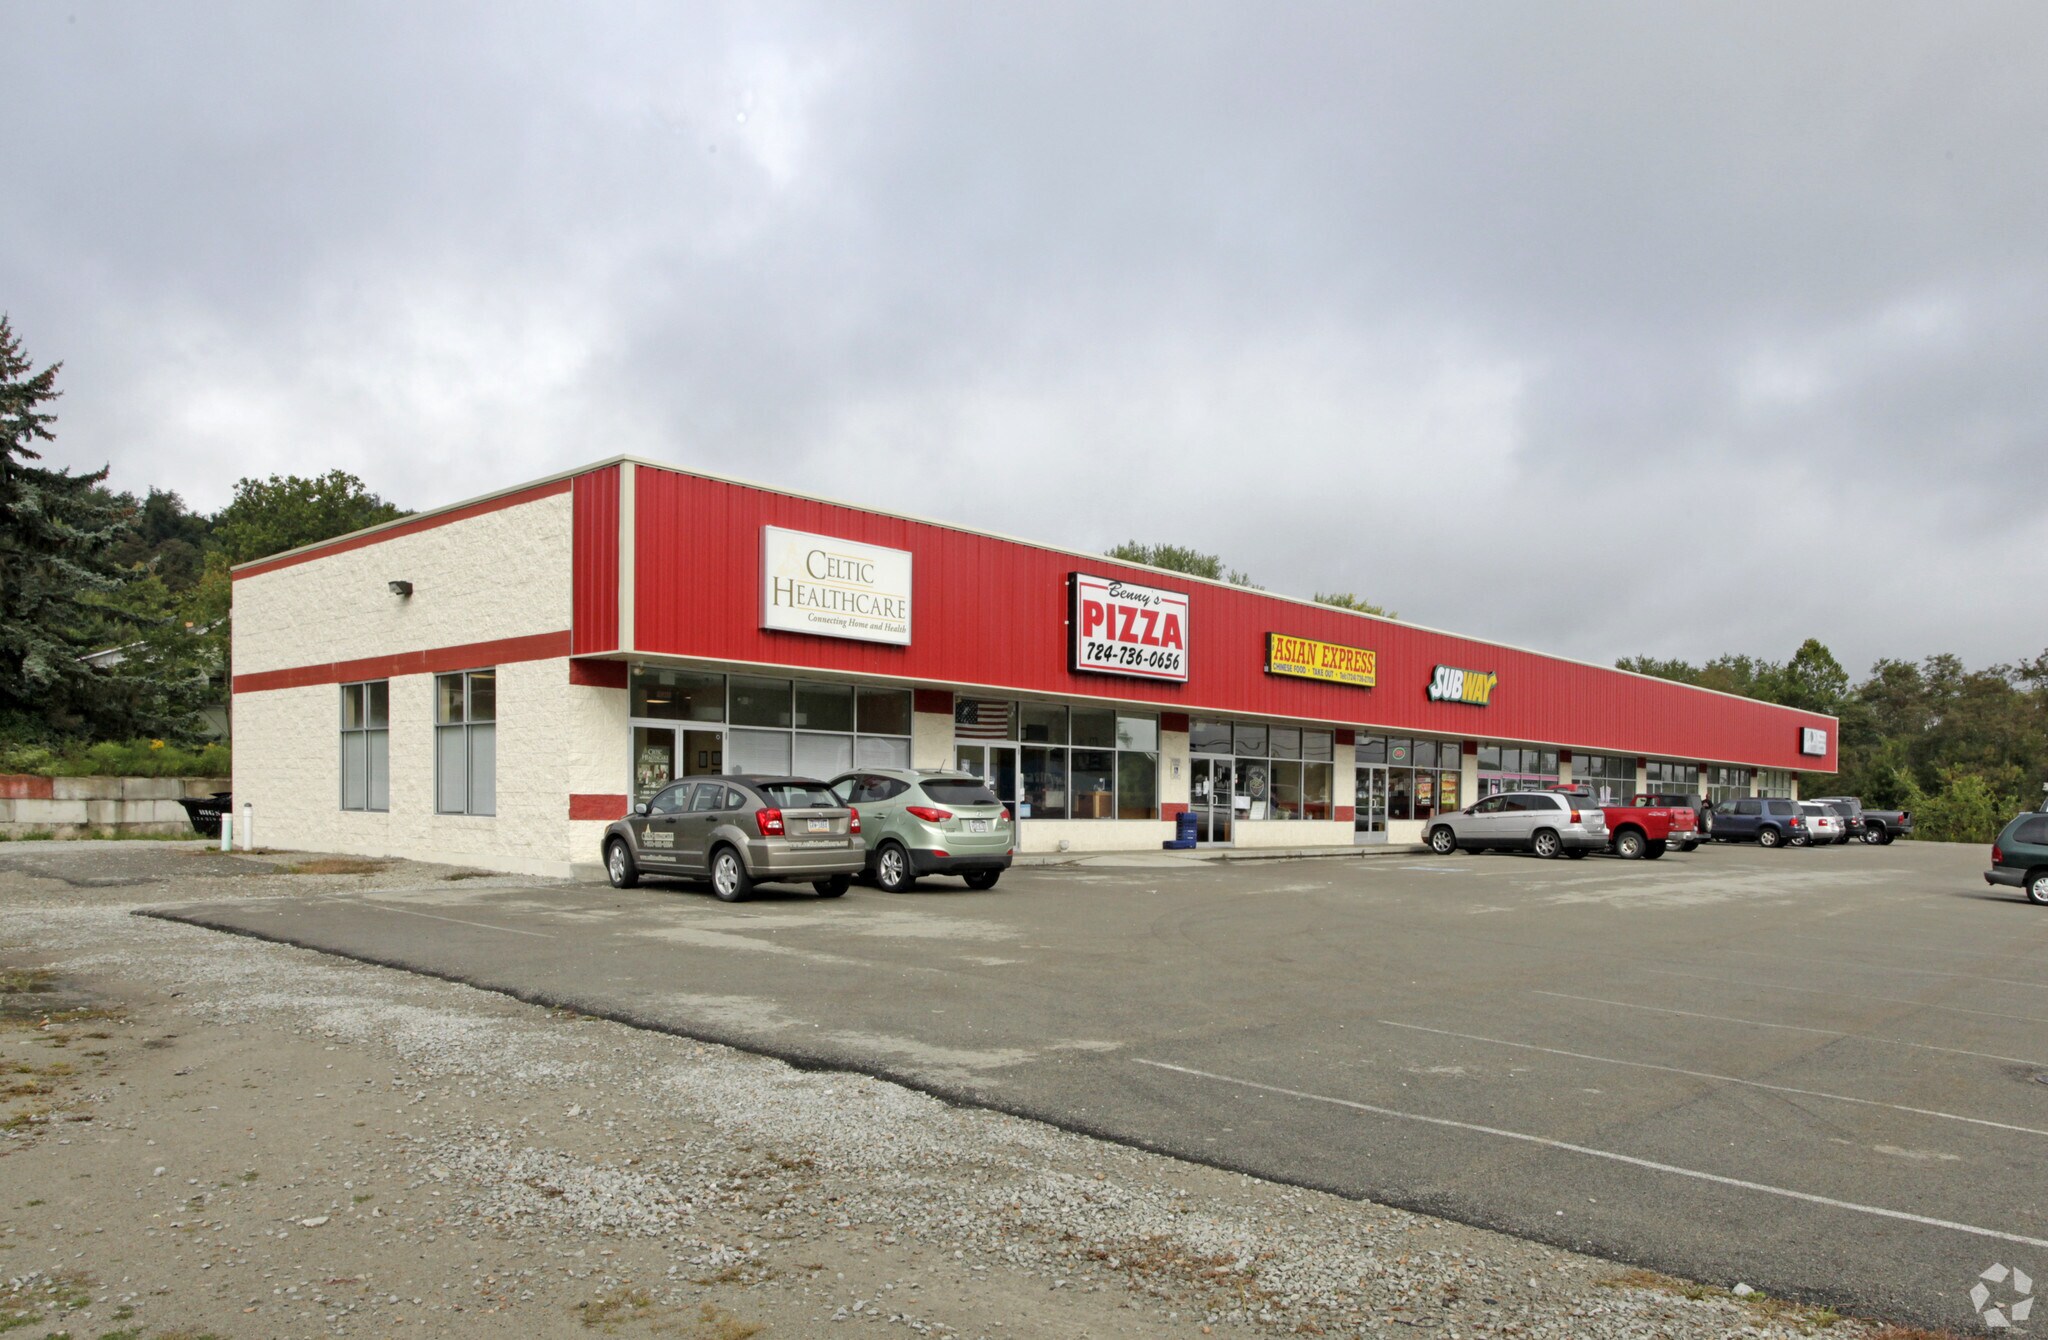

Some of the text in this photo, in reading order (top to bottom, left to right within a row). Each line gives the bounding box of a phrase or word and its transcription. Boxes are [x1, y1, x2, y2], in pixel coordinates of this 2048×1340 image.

[806, 550, 875, 584] CELTIC
[773, 576, 906, 620] HEALTHCARE
[808, 612, 907, 634] Connecting Home and Health
[1083, 599, 1183, 650] PIZZA
[1087, 642, 1180, 670] 724-736-0656
[1273, 637, 1374, 674] ASIAN EXPRESS
[1273, 662, 1293, 672] CHINESE
[1293, 665, 1307, 674] FOOD
[1312, 667, 1324, 677] TAKE
[1325, 669, 1334, 678] OUT
[1430, 666, 1497, 703] SUBWAY
